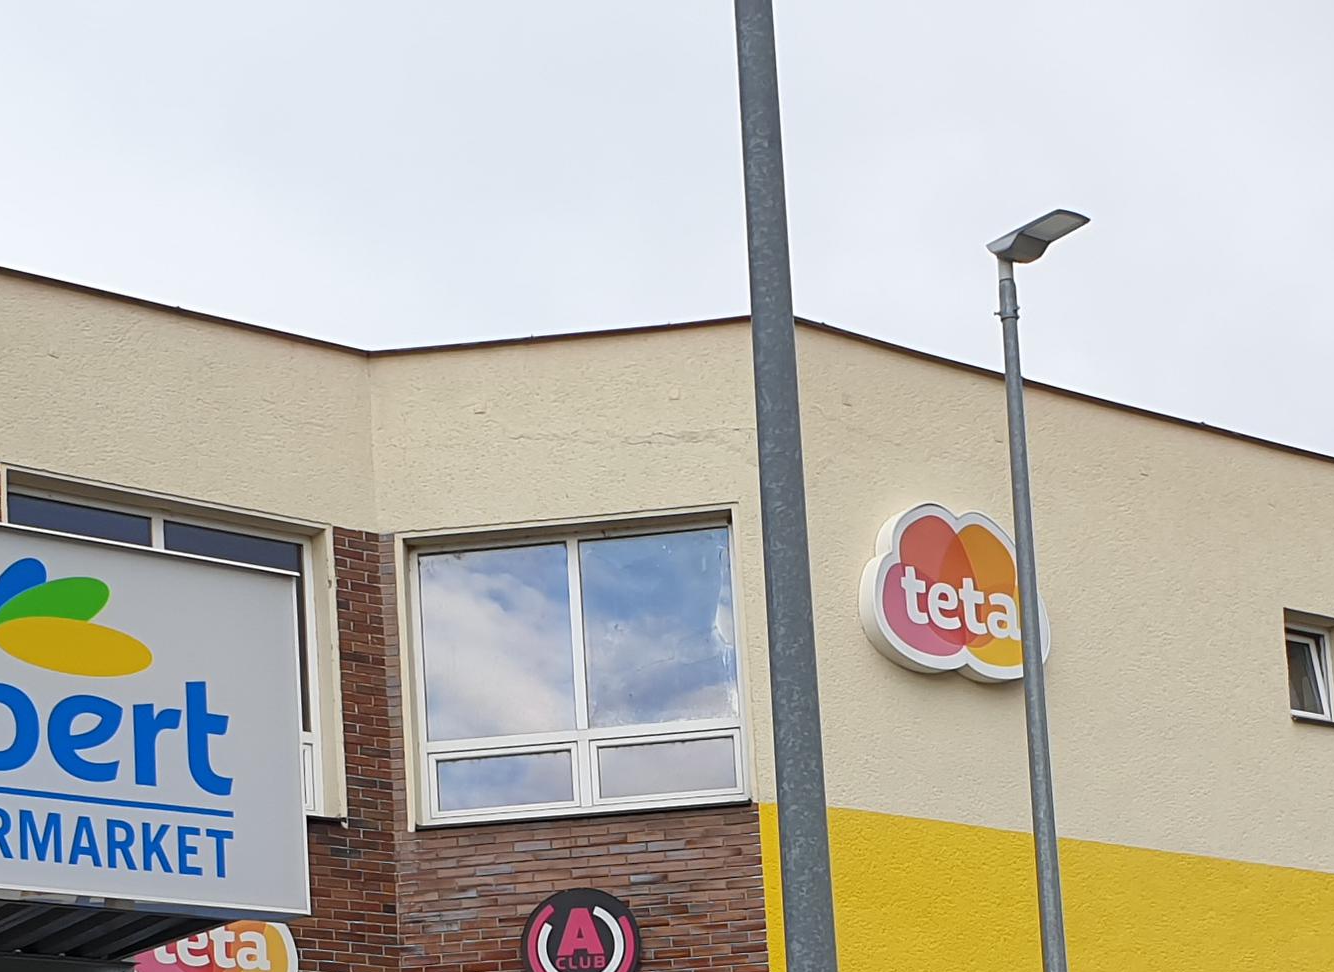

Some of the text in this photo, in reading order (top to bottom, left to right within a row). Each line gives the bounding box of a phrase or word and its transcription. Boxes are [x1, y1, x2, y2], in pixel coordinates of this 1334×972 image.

[901, 566, 1021, 640] teta
[557, 907, 605, 956] A
[555, 955, 607, 970] CLUB
